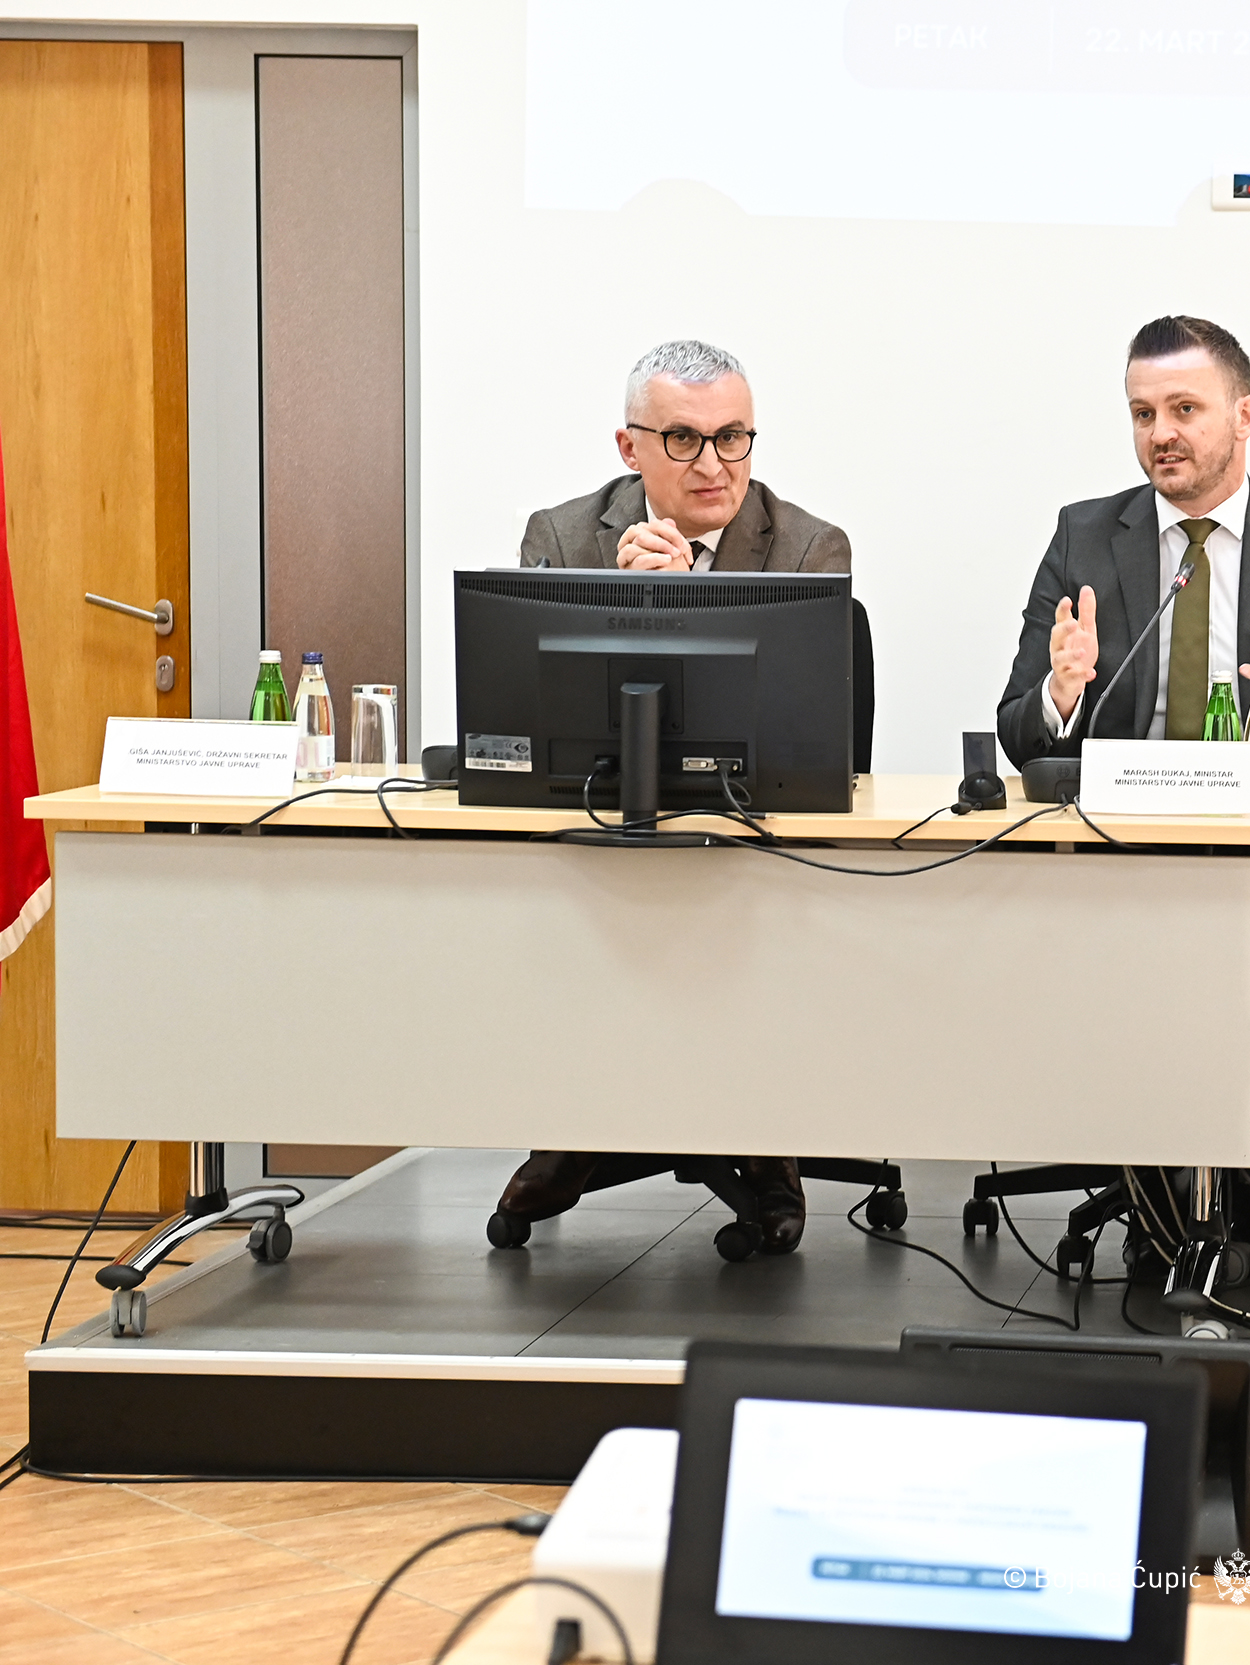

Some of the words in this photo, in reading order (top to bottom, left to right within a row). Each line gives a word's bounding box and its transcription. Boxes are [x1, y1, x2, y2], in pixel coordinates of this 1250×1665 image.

[894, 23, 989, 50] PETAK
[1085, 27, 1130, 53] 22.
[1138, 28, 1225, 55] MART
[244, 752, 288, 760] SEKRETAR
[136, 758, 197, 767] MINISTARSTVO
[199, 760, 225, 768] JAVNE
[228, 761, 261, 769] UPRAVE
[1123, 769, 1159, 777] MARASH
[1161, 770, 1192, 778] DUKAJ,
[1194, 770, 1234, 778] MINISTAR
[1114, 778, 1177, 787] MINISTARSTVO
[1178, 779, 1205, 787] JAVNE
[1207, 780, 1241, 788] UPRAVE
